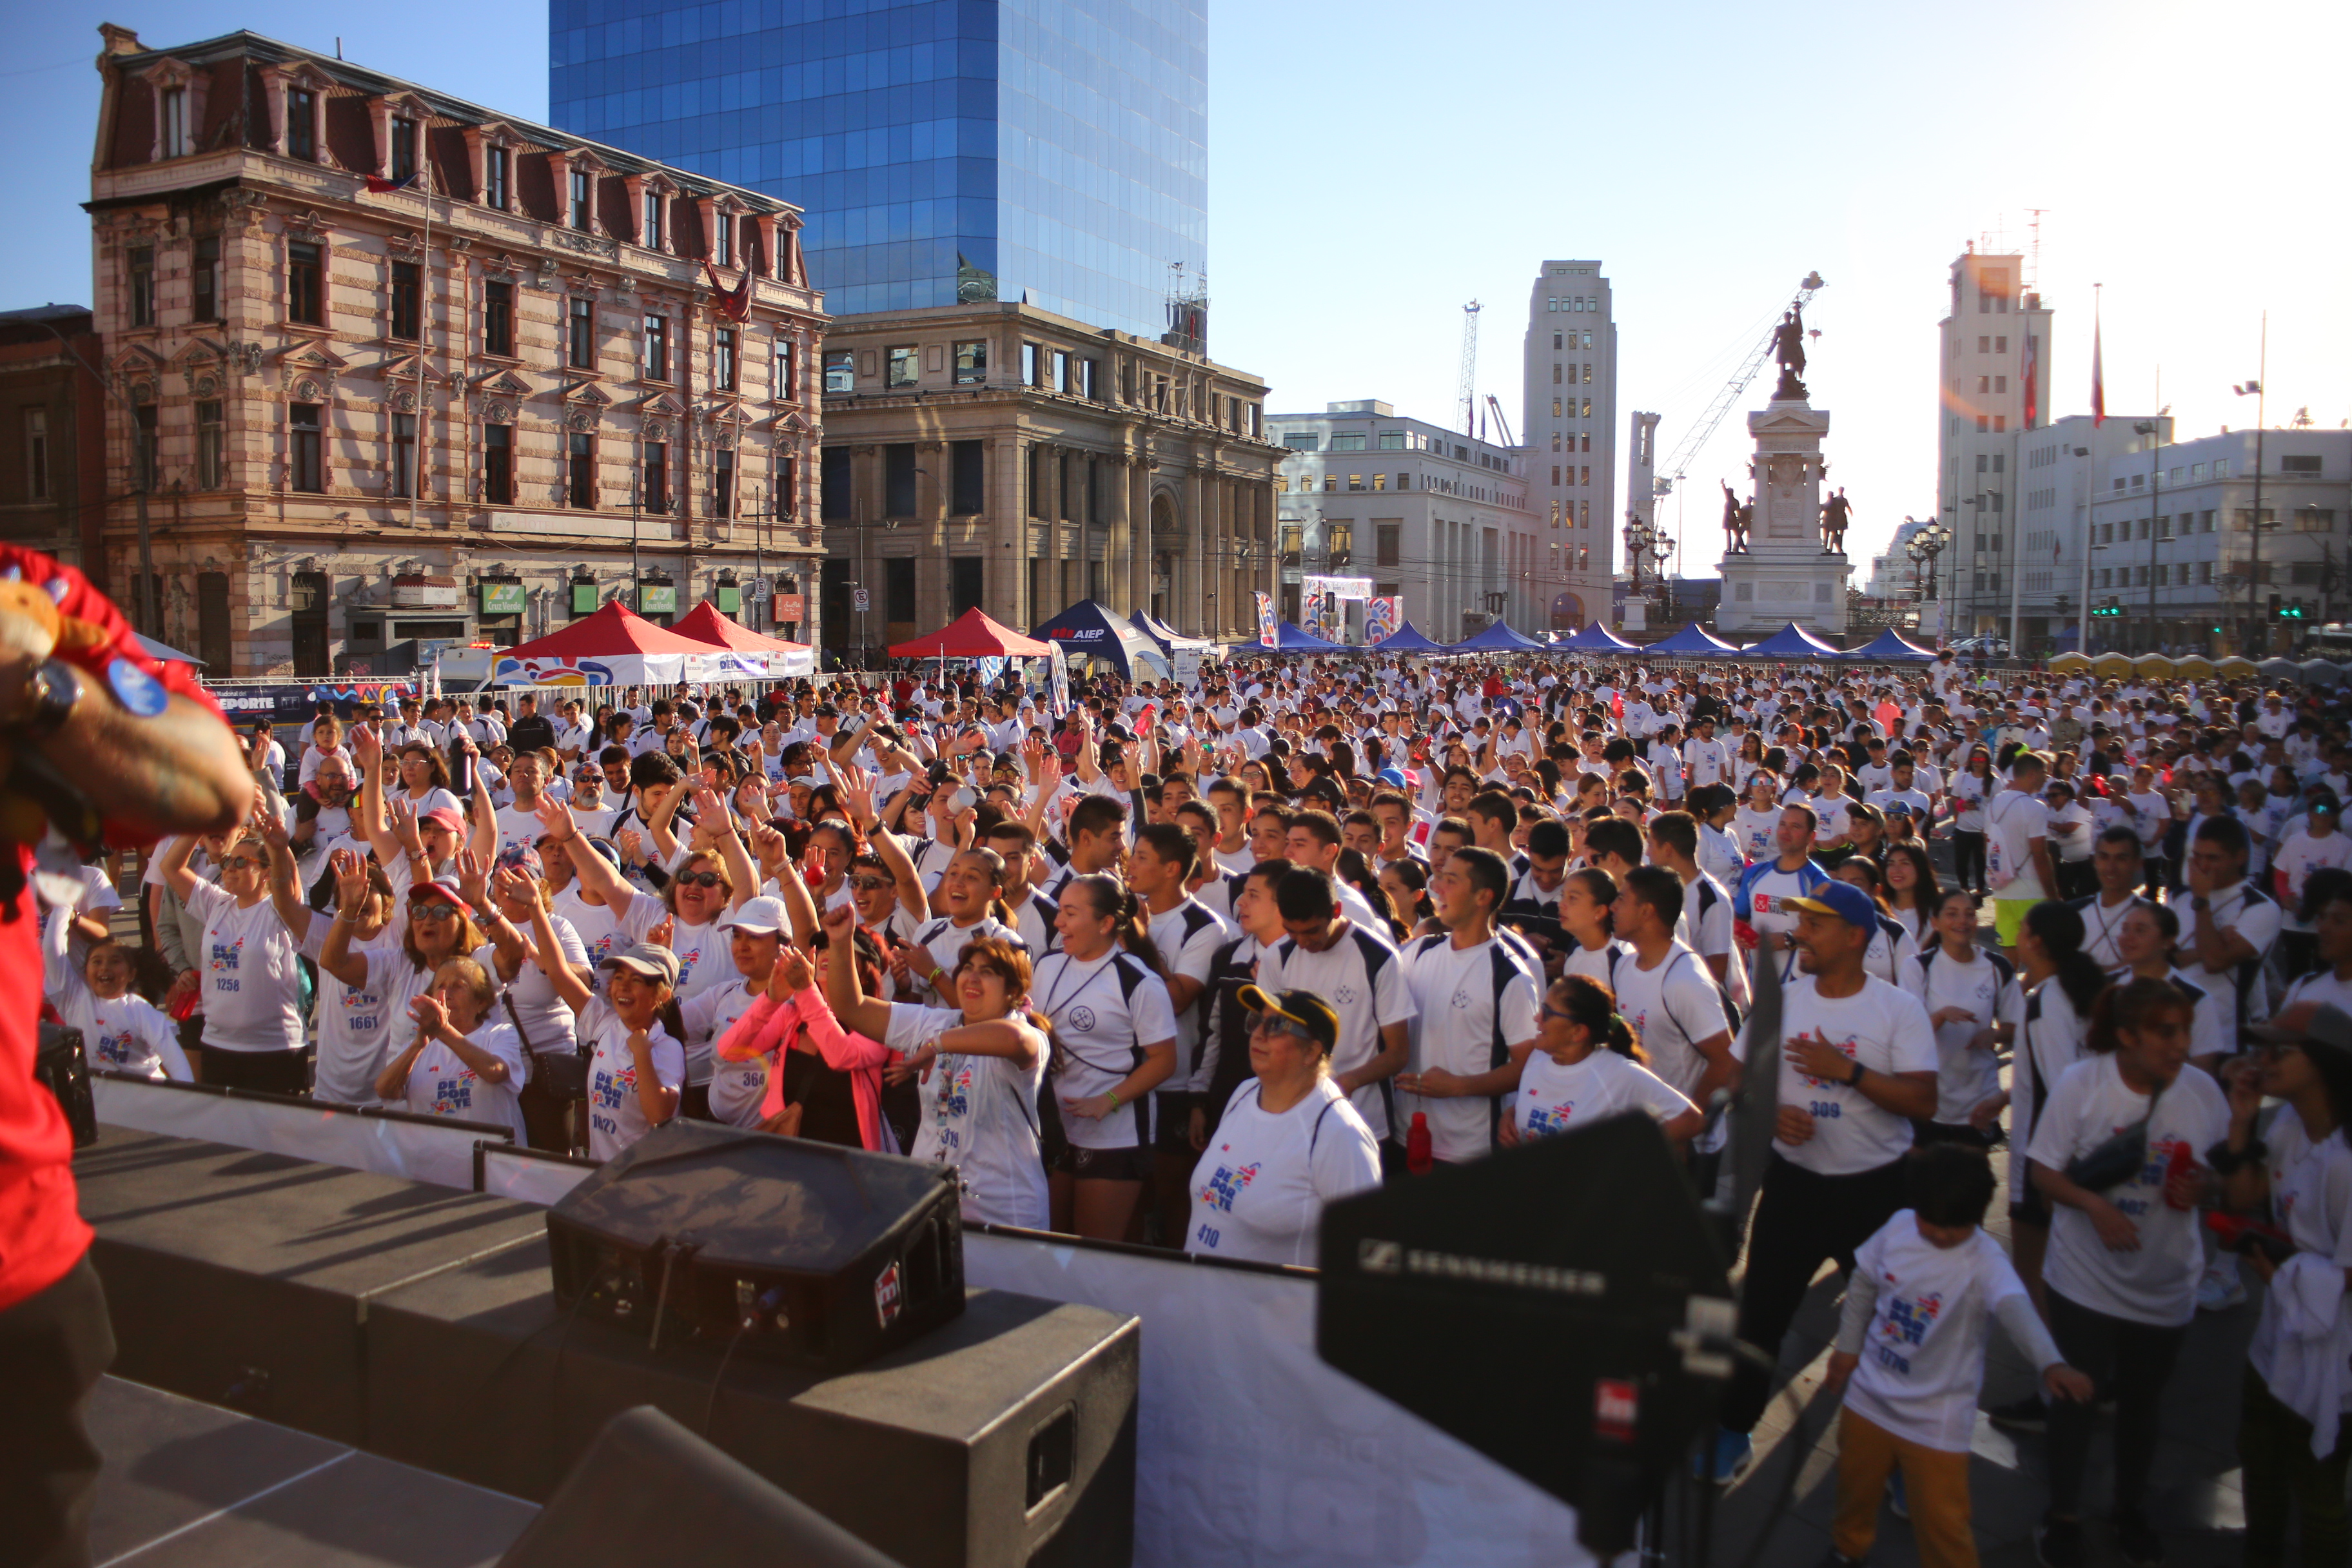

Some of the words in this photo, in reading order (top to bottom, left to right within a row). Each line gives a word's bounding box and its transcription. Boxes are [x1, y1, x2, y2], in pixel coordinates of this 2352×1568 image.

[516, 516, 558, 531] HOTEL
[488, 602, 502, 611] Cruz
[503, 601, 521, 611] Verde
[645, 602, 656, 610] Cruz
[657, 602, 673, 610] Verde
[1073, 629, 1104, 638] AIEP
[1122, 627, 1137, 639] AIEP
[213, 944, 227, 953] DE
[213, 952, 238, 961] POR
[226, 960, 239, 969] TE
[216, 977, 240, 992] 1258
[349, 1015, 378, 1030] 1661
[595, 1070, 613, 1084] DE
[438, 1079, 458, 1090] DE
[594, 1080, 623, 1099] POR
[437, 1087, 471, 1101] POR
[453, 1097, 472, 1108] TE
[605, 1095, 622, 1110] TE
[1810, 1100, 1841, 1119] 309
[1215, 1166, 1233, 1183] DE
[1209, 1177, 1236, 1200] POR
[1218, 1195, 1233, 1212] TE
[1197, 1222, 1220, 1248] 410
